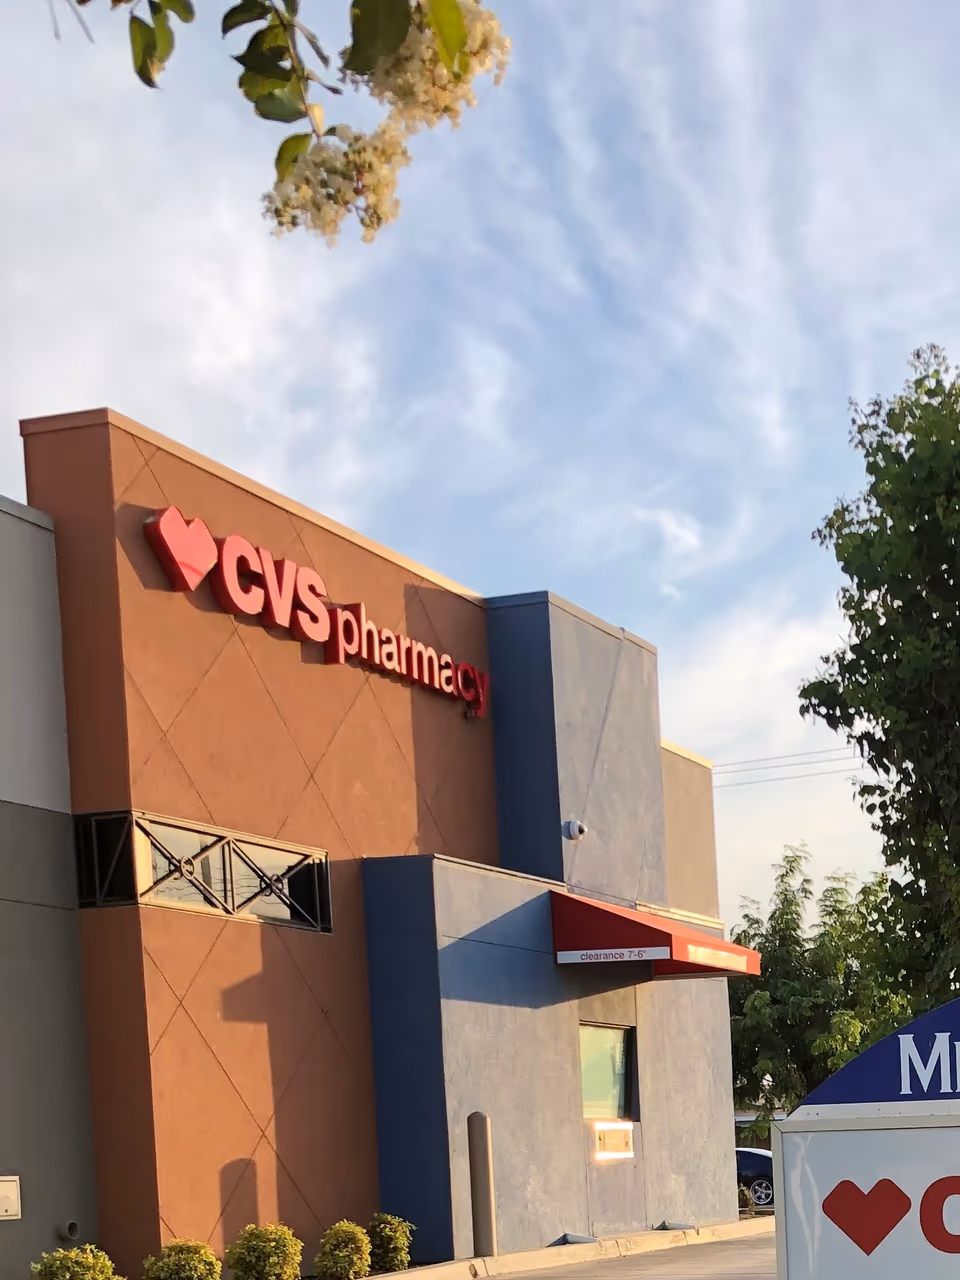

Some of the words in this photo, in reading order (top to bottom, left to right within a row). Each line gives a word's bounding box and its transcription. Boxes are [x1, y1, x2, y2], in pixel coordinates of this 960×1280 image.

[220, 535, 331, 642] CVS
[333, 602, 489, 718] pharmacy
[580, 950, 625, 961] clearance
